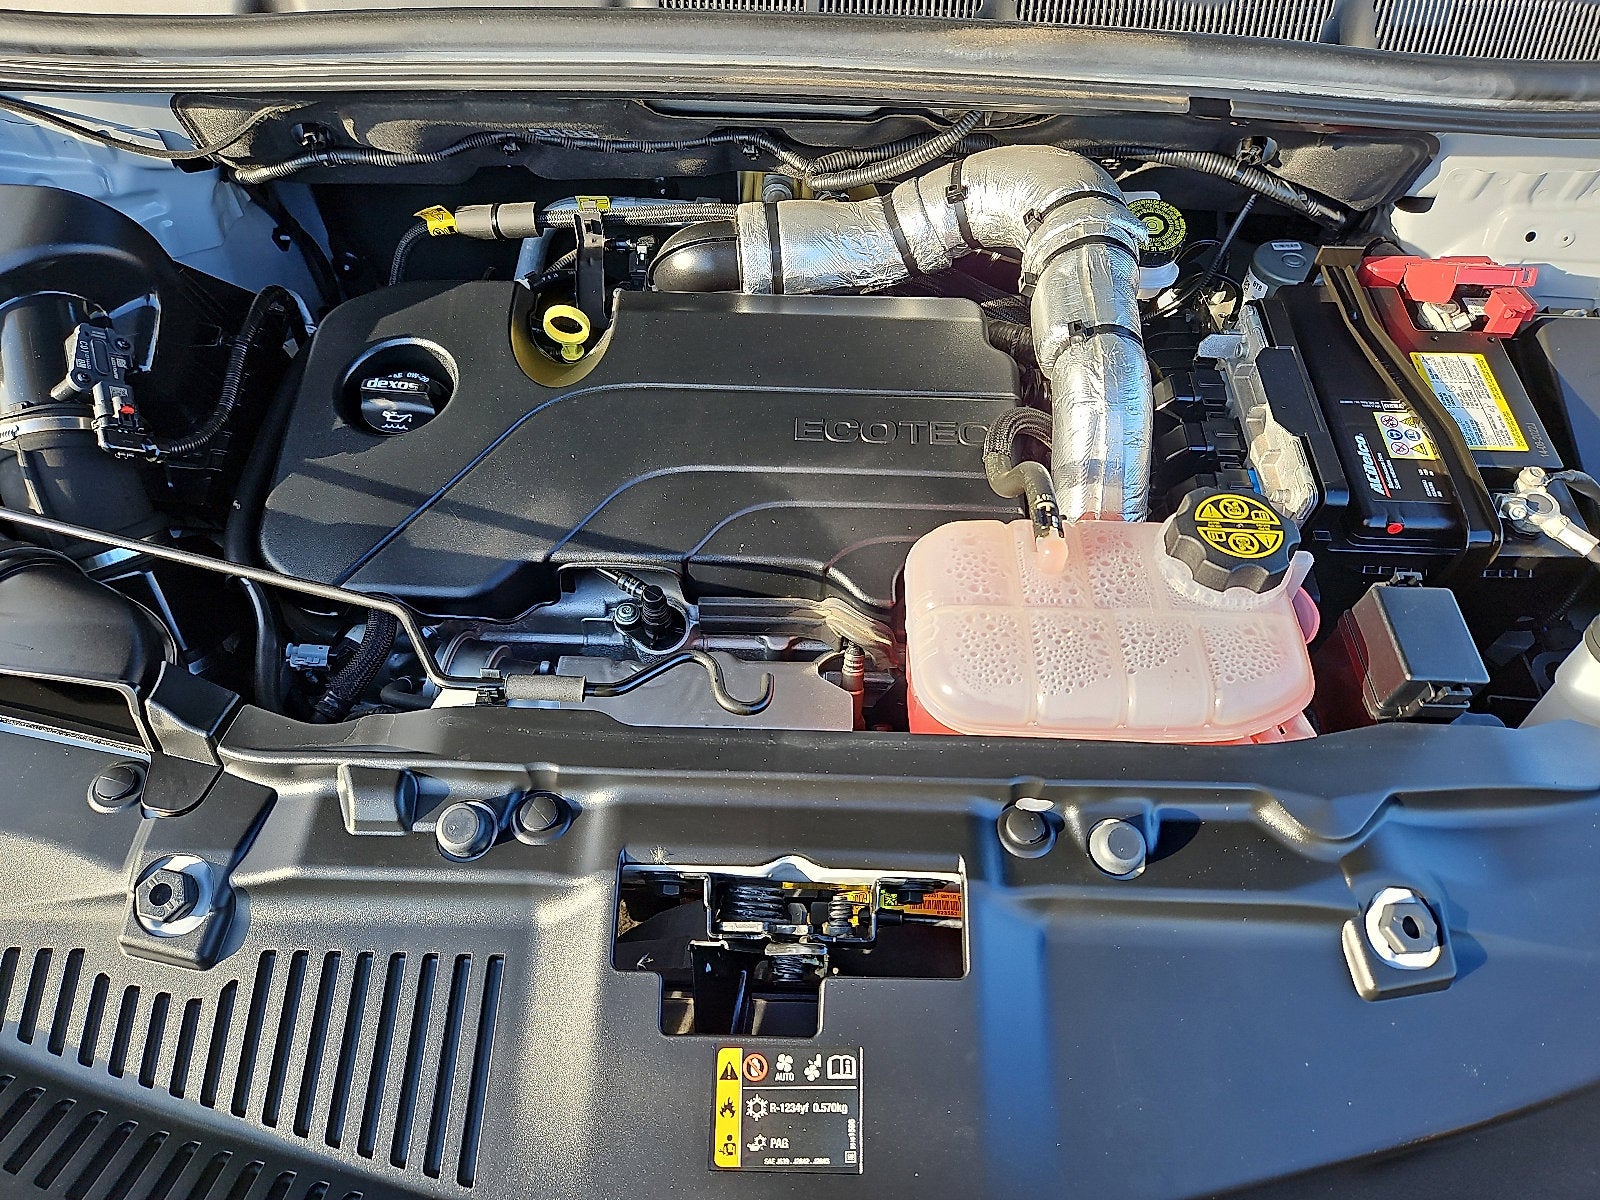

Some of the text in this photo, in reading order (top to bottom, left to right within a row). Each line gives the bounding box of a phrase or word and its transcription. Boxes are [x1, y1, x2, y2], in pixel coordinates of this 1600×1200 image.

[366, 378, 419, 391] dexos
[793, 416, 988, 447] ECOTEC
[1354, 434, 1387, 496] ACDelco
[774, 1072, 795, 1082] AUTO
[769, 1102, 849, 1115] R-1234yf 0.570kg
[769, 1137, 790, 1149] PAG
